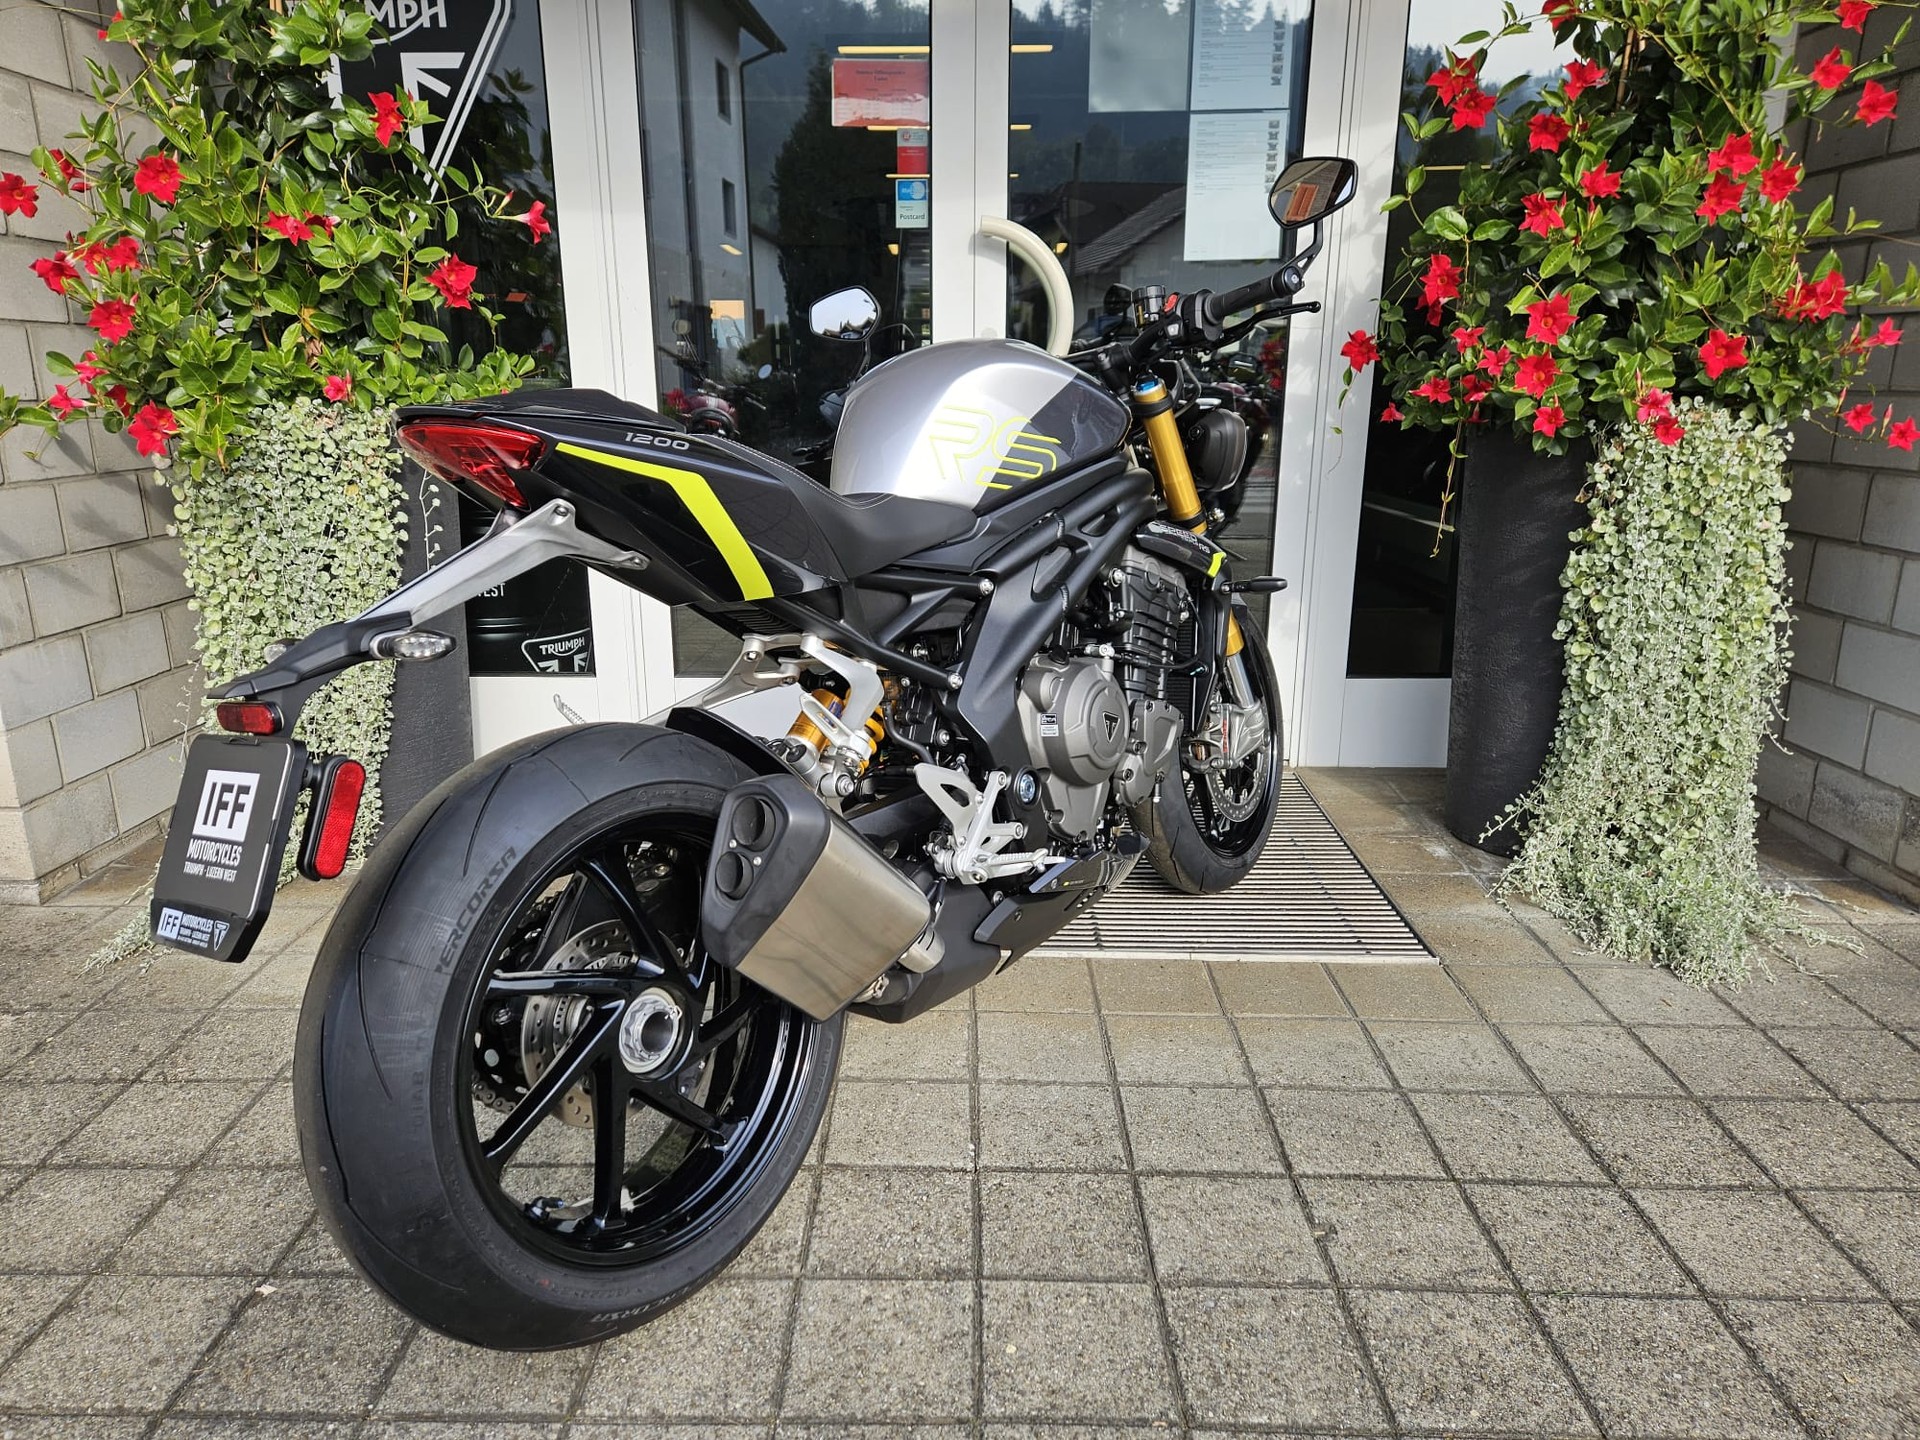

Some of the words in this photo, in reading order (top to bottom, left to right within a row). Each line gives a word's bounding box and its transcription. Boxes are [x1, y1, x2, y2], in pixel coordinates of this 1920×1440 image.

[899, 212, 926, 221] Postcard
[625, 432, 690, 451] 1200
[929, 405, 1062, 490] RS
[539, 636, 585, 655] TRIUMPH
[202, 781, 252, 830] IFF
[186, 838, 243, 867] MOTORCYCLES
[161, 913, 179, 934] IFF
